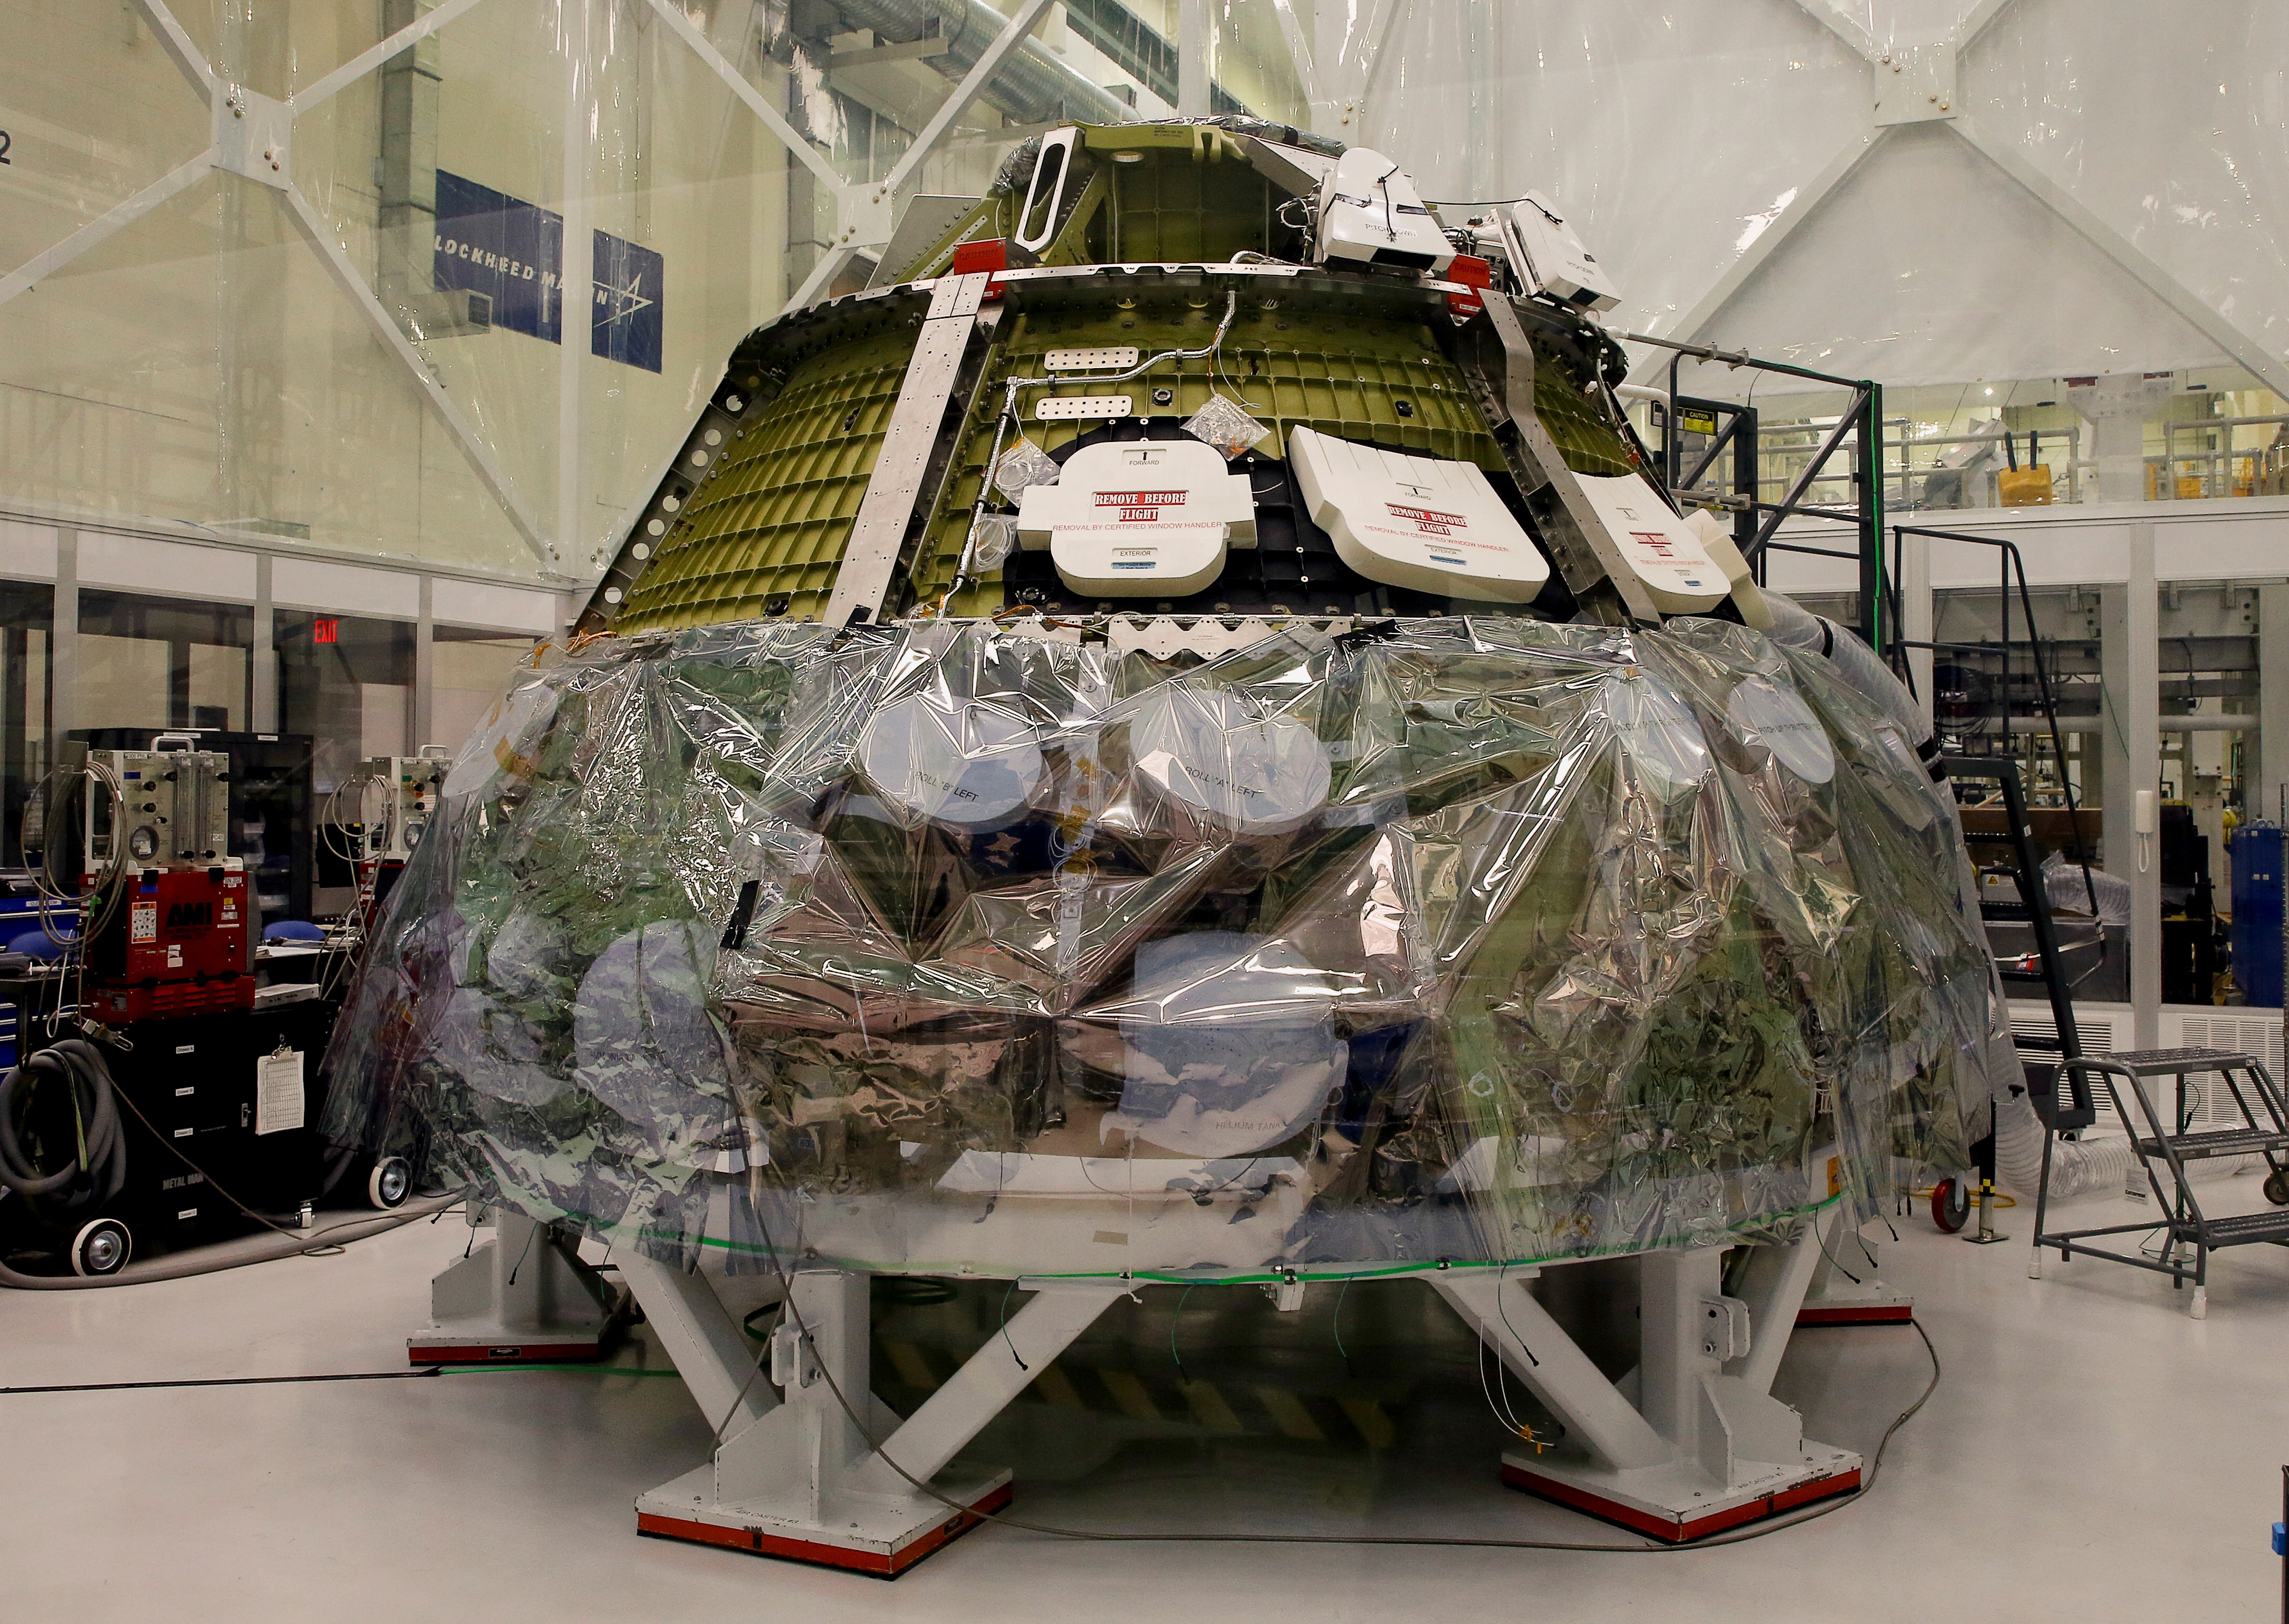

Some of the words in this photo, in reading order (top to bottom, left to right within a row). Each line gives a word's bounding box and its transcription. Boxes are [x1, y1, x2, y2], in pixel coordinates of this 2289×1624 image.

[434, 235, 535, 281] LOCKHEED
[1689, 411, 1709, 420] CAUTION
[1095, 494, 1138, 505] REMOVE
[1144, 493, 1185, 504] BEFORE
[1119, 509, 1158, 520] FLIGHT
[1388, 506, 1427, 520] REMOVE
[1429, 513, 1467, 526] BEFORE
[1365, 525, 1399, 535] REMOVAL
[1410, 533, 1446, 543] CERTIFIED
[1447, 539, 1476, 547] WINDOW
[1477, 543, 1509, 552] HANDLER
[1416, 522, 1450, 535] FLIGHT
[314, 620, 338, 643] EXIT
[913, 771, 937, 786] ROLL
[954, 787, 979, 802] LEFT
[1185, 766, 1210, 782] ROLL
[1232, 784, 1257, 799] LEFT
[167, 902, 213, 927] AMI
[1216, 1121, 1253, 1130] HELIUM
[1257, 1122, 1282, 1131] TANK
[163, 1176, 186, 1190] METAL
